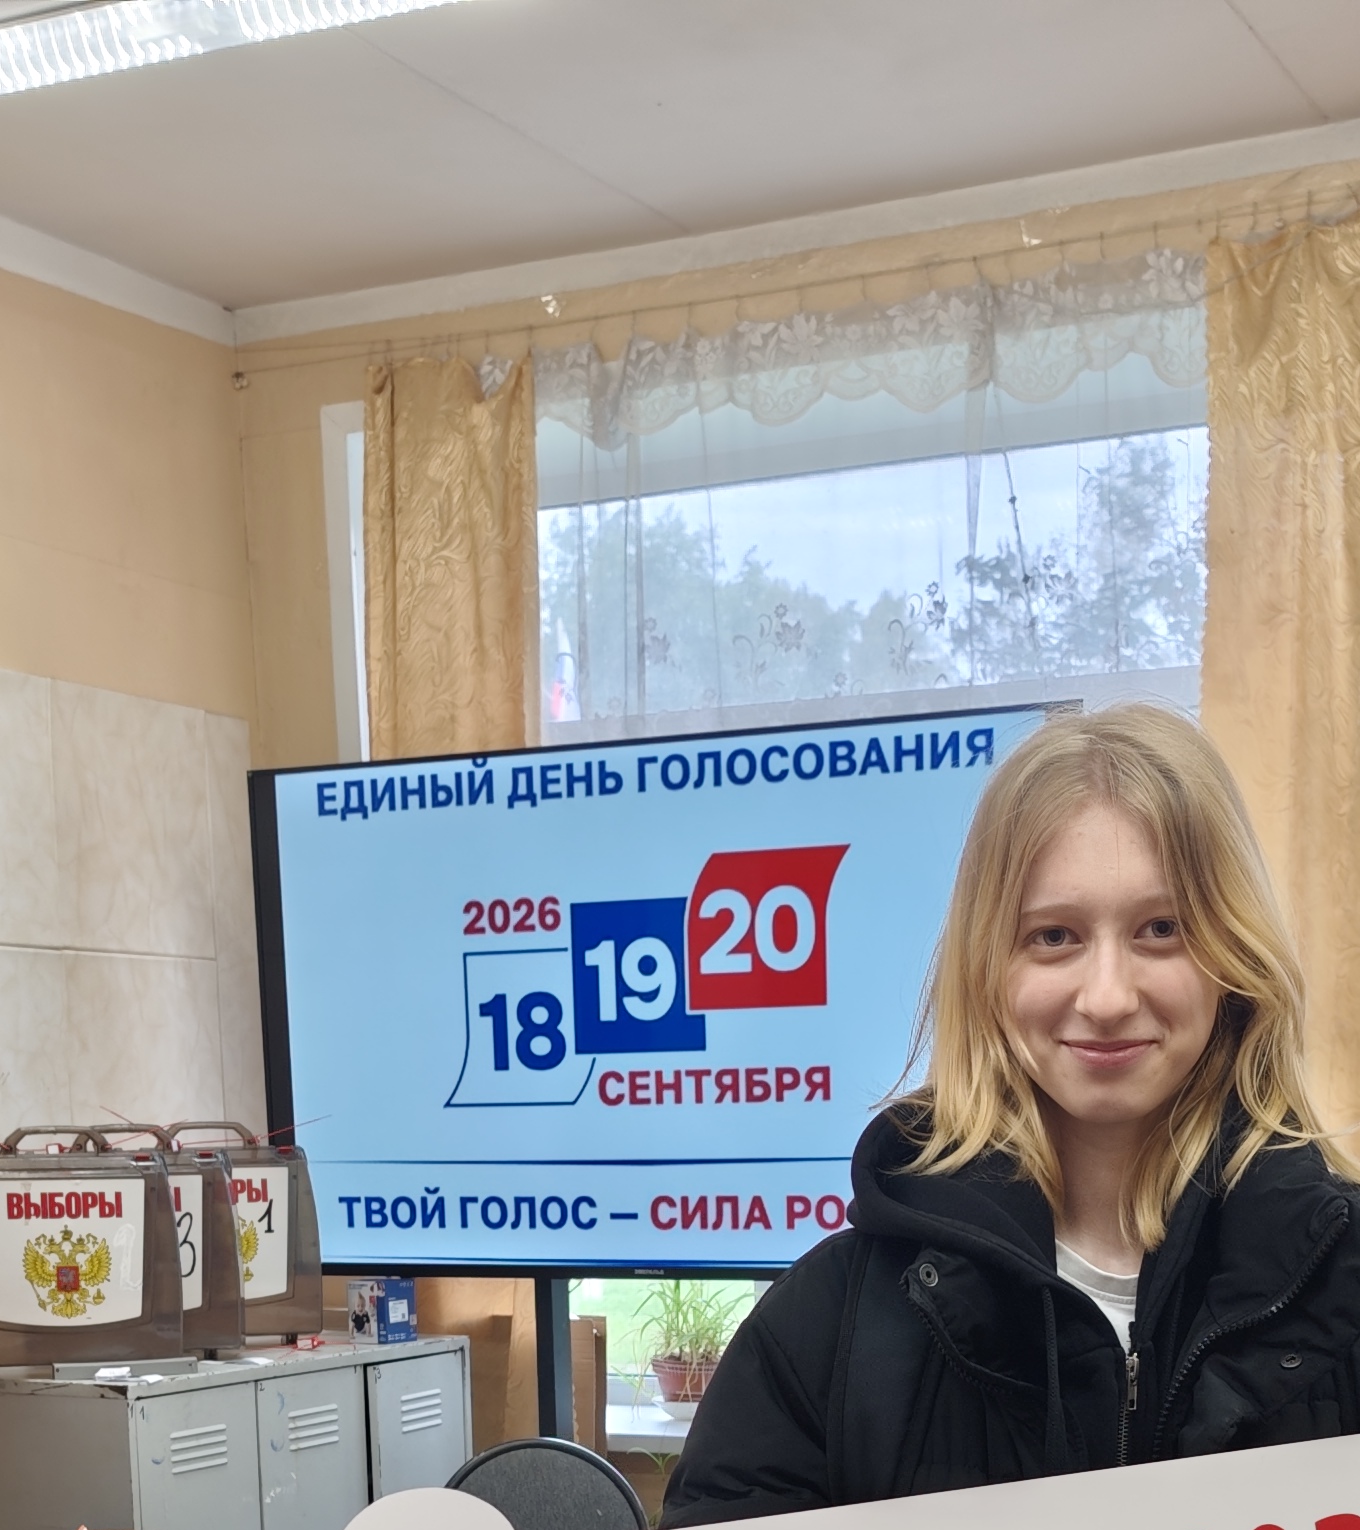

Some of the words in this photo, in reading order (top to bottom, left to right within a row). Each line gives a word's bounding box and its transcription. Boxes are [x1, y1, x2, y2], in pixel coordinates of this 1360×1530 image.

[316, 758, 496, 821] ЕДИНЫЙ
[506, 760, 624, 809] ДЕНЬ
[636, 727, 995, 794] ГОЛОСОВАНИЯ
[463, 896, 562, 936] 2026
[698, 884, 816, 975] 20
[584, 936, 677, 1022] 19
[479, 991, 567, 1072] 18
[597, 1065, 832, 1107] СЕНТЯБРЯ
[6, 1191, 123, 1220] ВЫБОРЫ
[257, 1198, 275, 1234] 1
[338, 1187, 446, 1231] ТВОЙ
[459, 1195, 598, 1231] ГОЛОС
[650, 1195, 773, 1231] СИЛА
